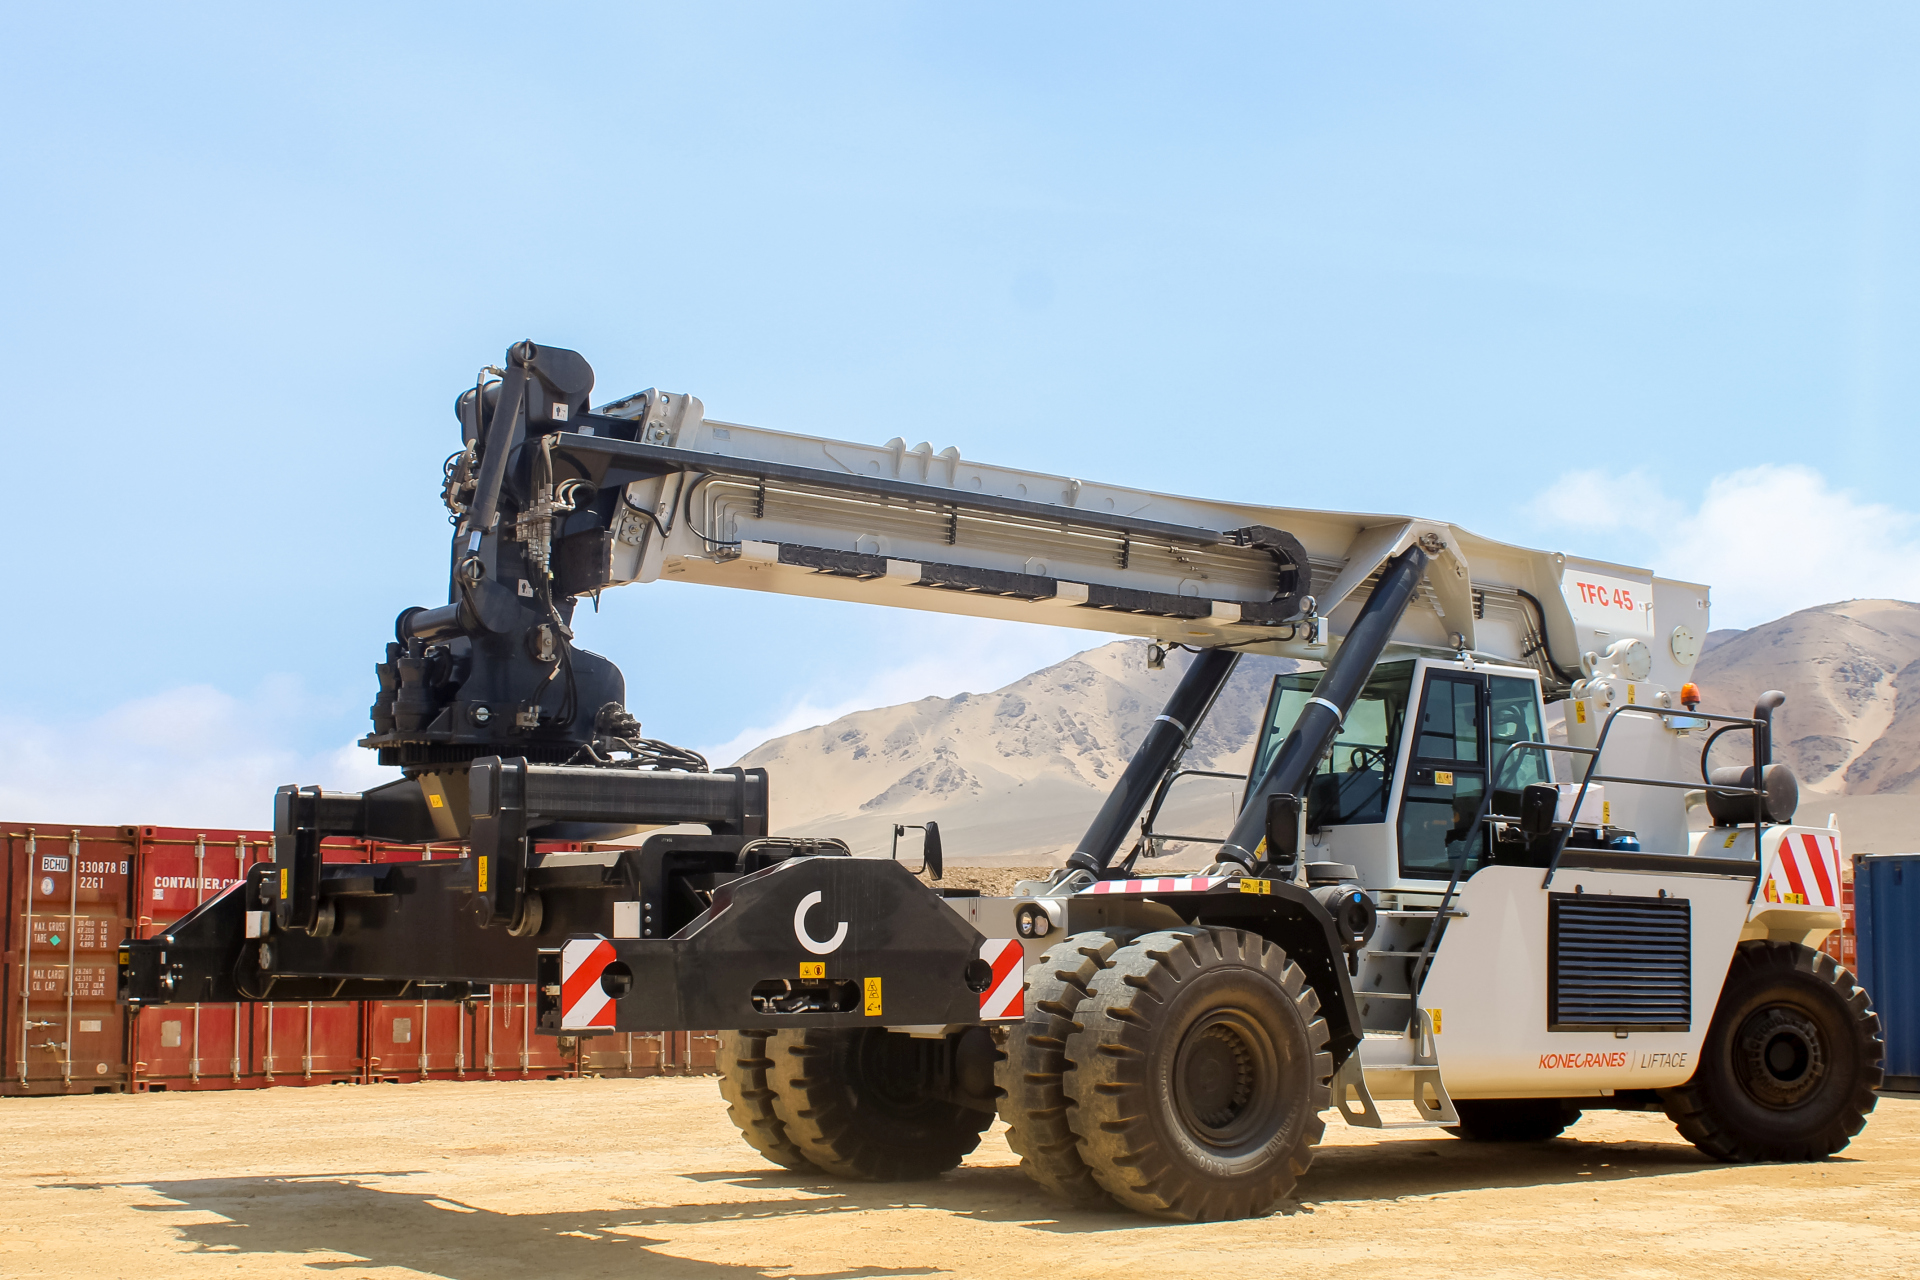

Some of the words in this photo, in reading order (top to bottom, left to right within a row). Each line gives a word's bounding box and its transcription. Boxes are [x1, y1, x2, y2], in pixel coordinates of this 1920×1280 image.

[1577, 582, 1609, 607] TFC
[1613, 588, 1634, 611] 45
[43, 858, 67, 870] BCHU
[79, 861, 116, 874] 330878
[80, 876, 104, 889] 22G1
[154, 876, 238, 889] CONTAIER.C
[48, 922, 65, 931] GROSS
[33, 933, 47, 943] TARE
[47, 970, 65, 979] CARGO
[1538, 1052, 1626, 1069] KONECRANES
[1641, 1052, 1688, 1069] LIFTACE
